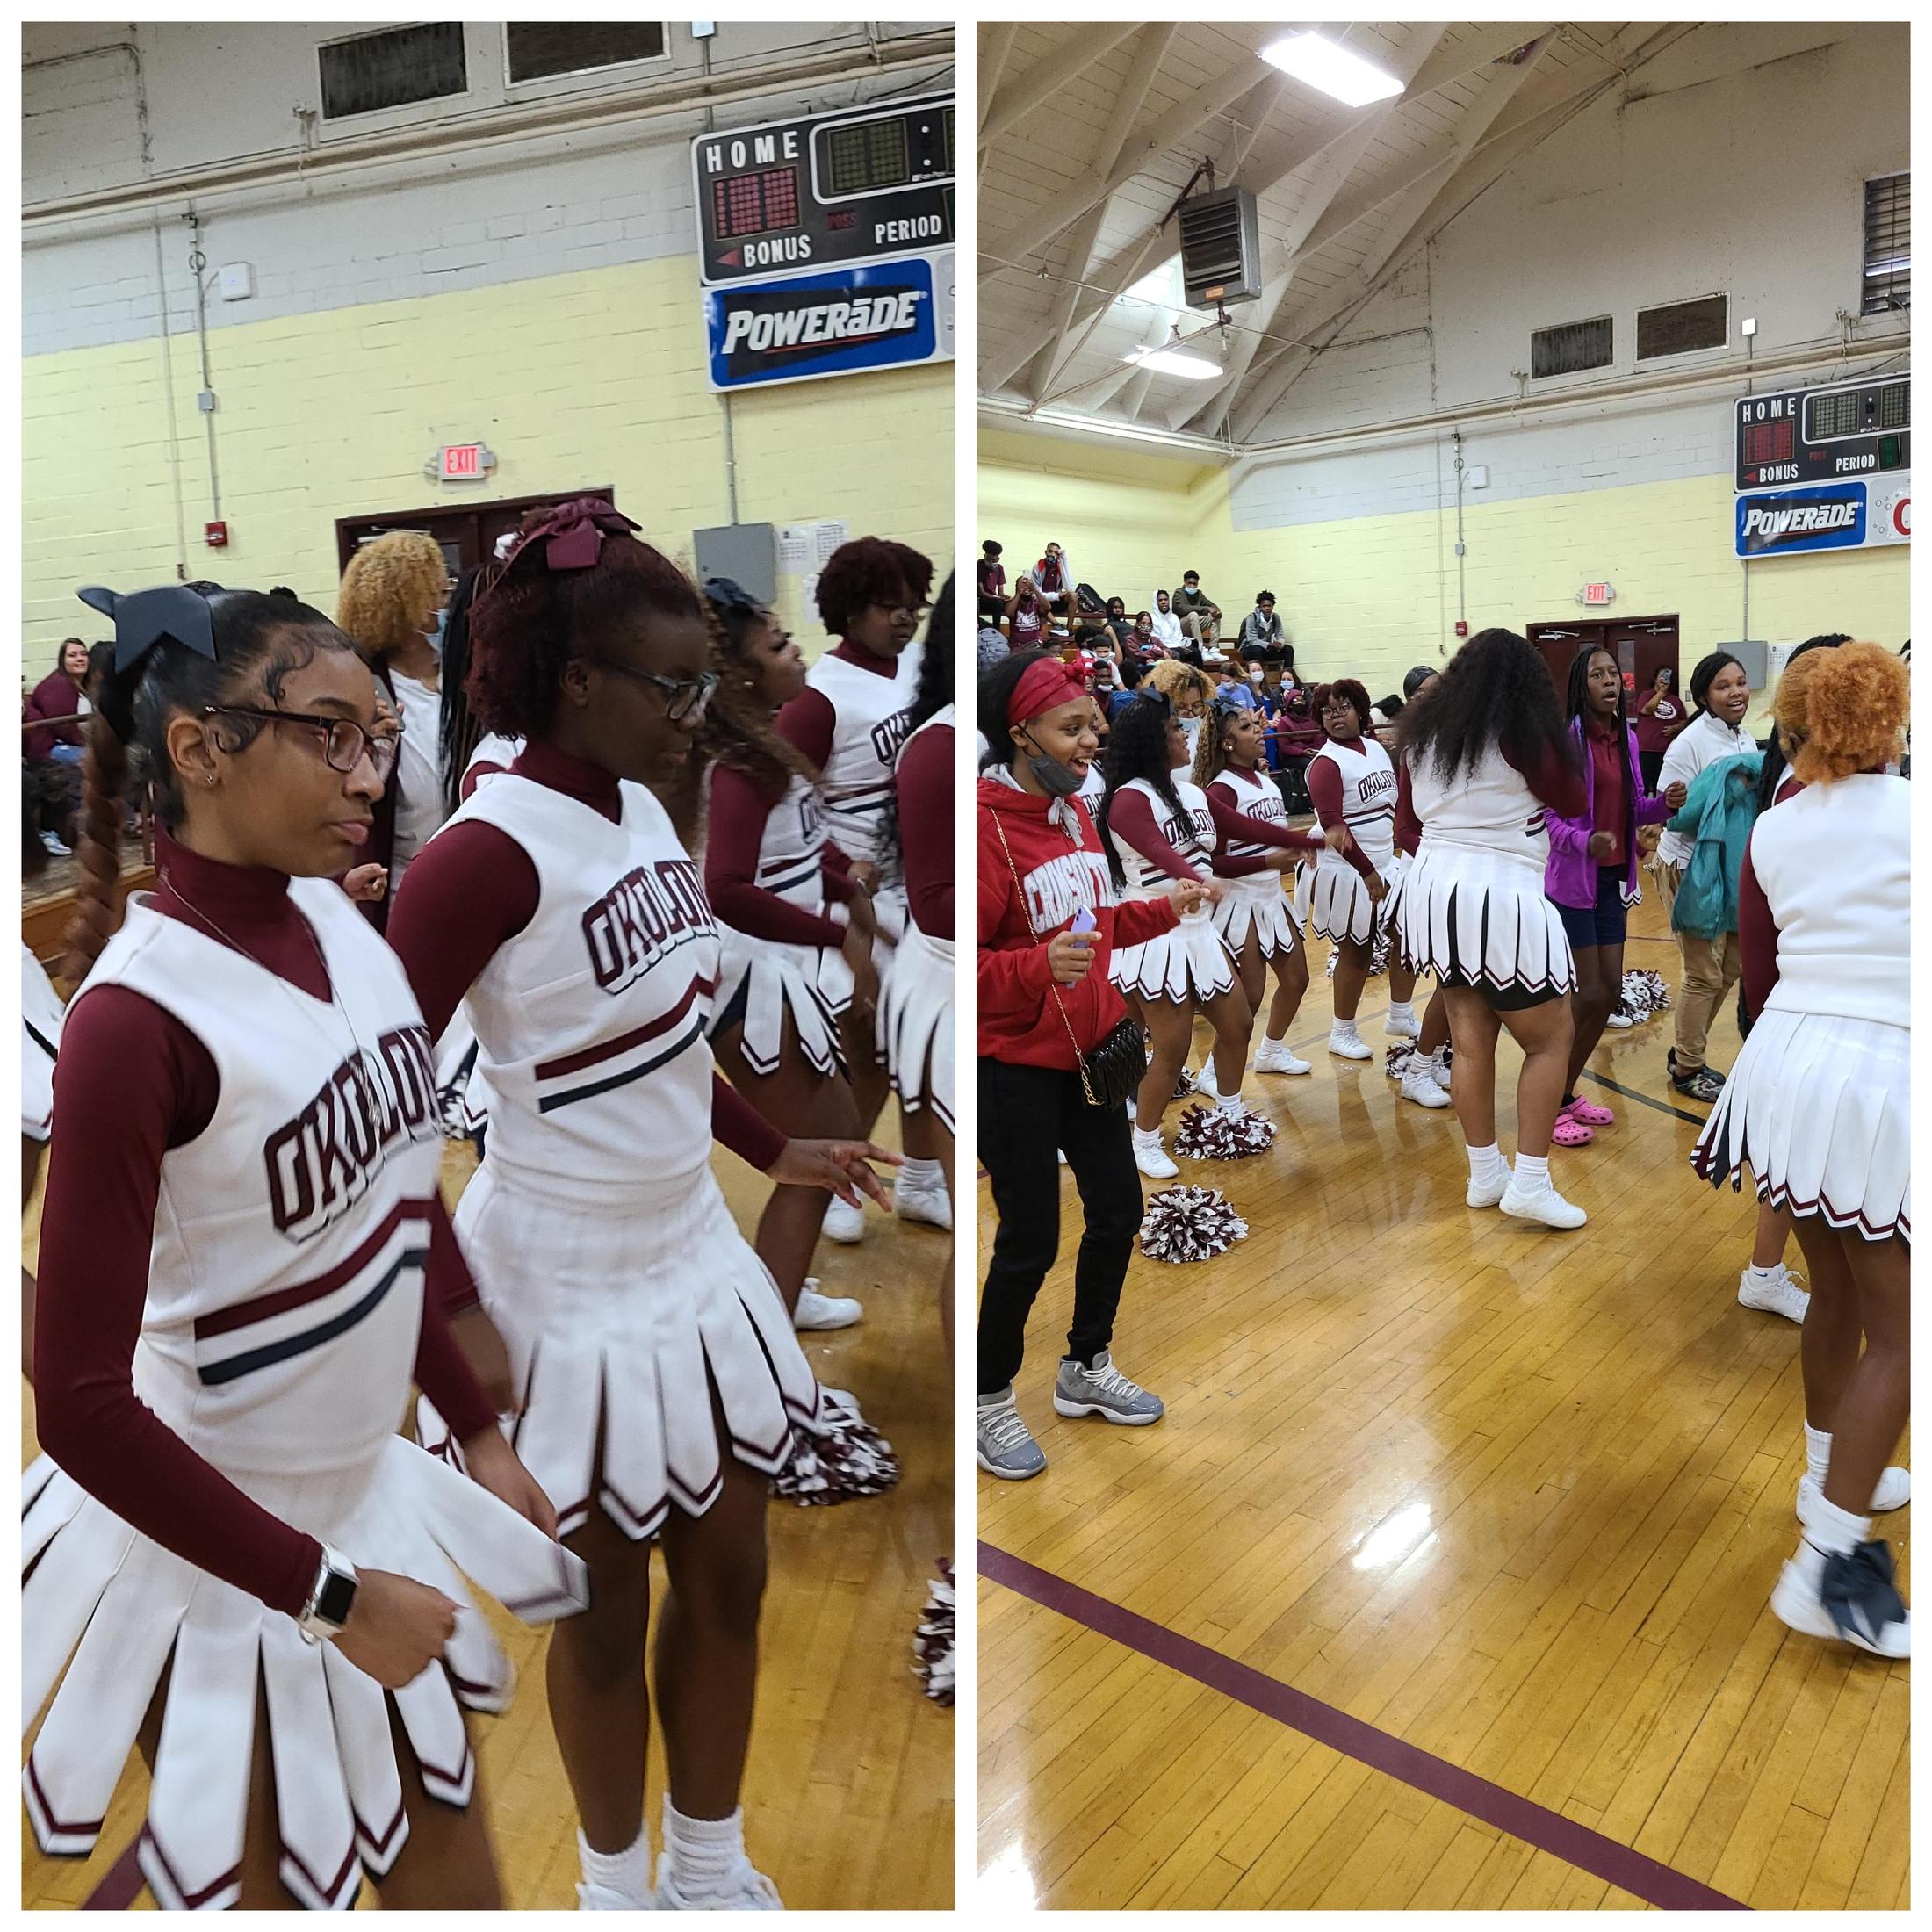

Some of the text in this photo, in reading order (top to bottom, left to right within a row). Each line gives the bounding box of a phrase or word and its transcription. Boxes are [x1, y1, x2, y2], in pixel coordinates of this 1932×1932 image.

[706, 131, 799, 173] HOME
[875, 215, 941, 244] PERIOD
[743, 234, 811, 267] BONUS
[1742, 397, 1797, 422] HOME
[447, 447, 478, 474] EXIT
[1759, 463, 1799, 483] BONUS
[1835, 454, 1876, 472] PERIOD
[1587, 585, 1605, 601] EXIT
